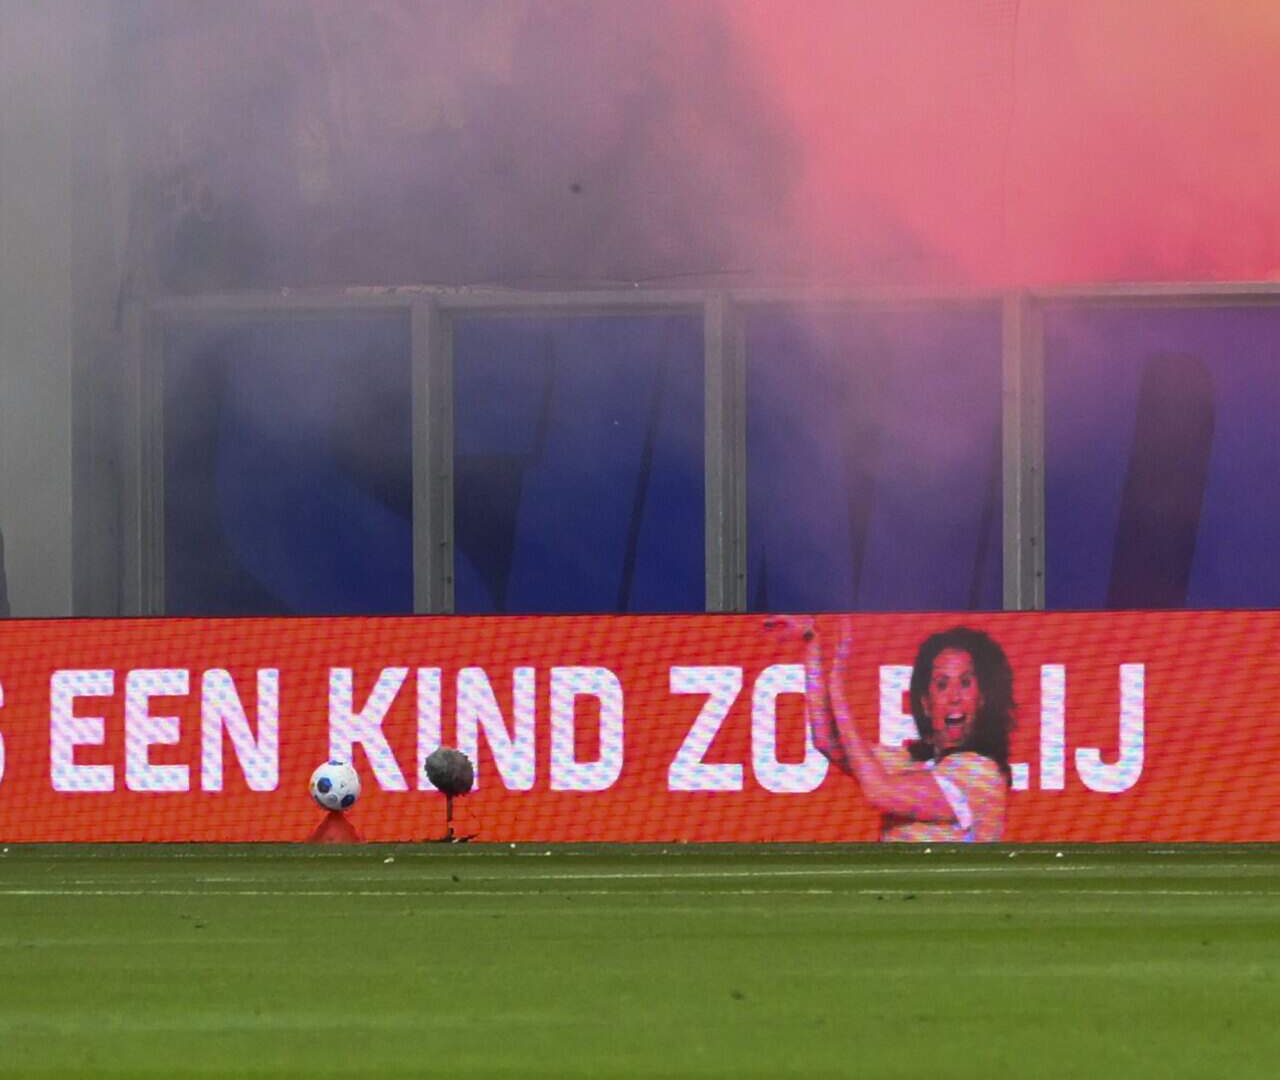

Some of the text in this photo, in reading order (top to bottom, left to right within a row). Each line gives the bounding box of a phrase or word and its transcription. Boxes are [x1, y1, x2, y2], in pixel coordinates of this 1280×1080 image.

[49, 668, 279, 792] EEN
[328, 666, 625, 792] KIND
[667, 663, 830, 793] ZO
[879, 663, 1145, 793] IJ
